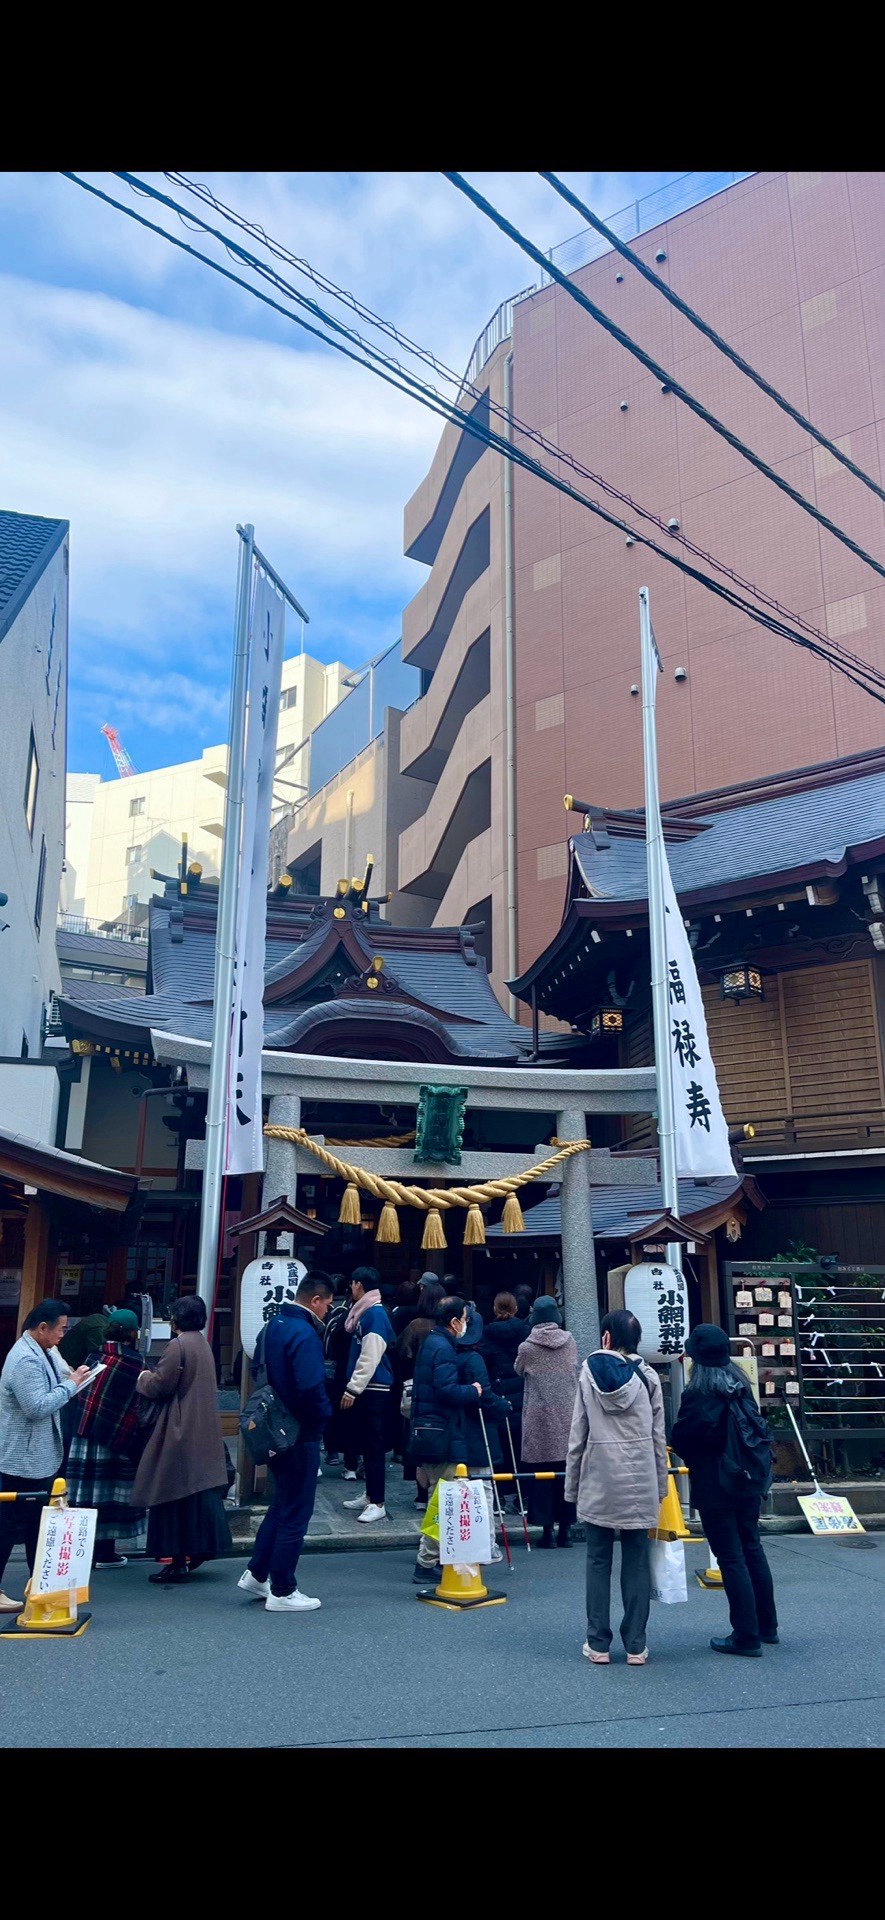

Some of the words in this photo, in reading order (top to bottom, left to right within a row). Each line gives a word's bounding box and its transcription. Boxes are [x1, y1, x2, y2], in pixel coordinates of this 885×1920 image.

[657, 1289, 685, 1355] 小網神社
[56, 1515, 75, 1577] 写真撮影
